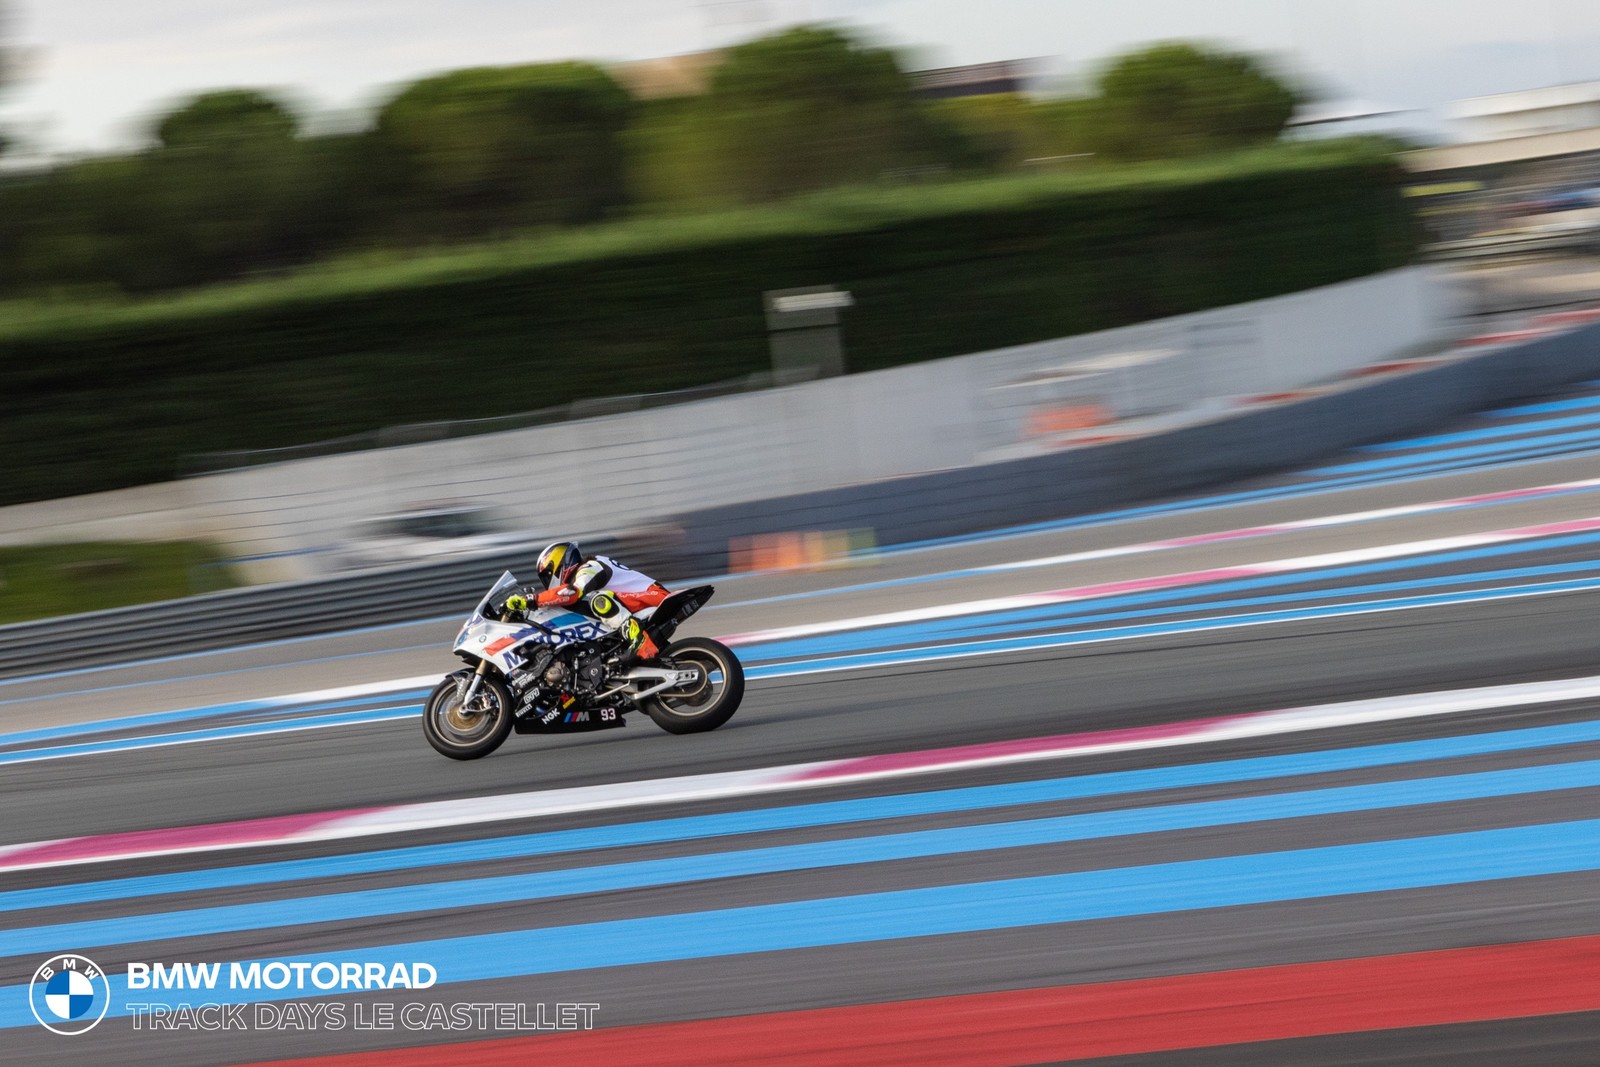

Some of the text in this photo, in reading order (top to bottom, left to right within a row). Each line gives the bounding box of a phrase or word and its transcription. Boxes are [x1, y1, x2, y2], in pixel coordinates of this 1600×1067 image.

[502, 621, 608, 670] MOREX
[541, 708, 561, 725] NGK
[600, 707, 617, 721] 93
